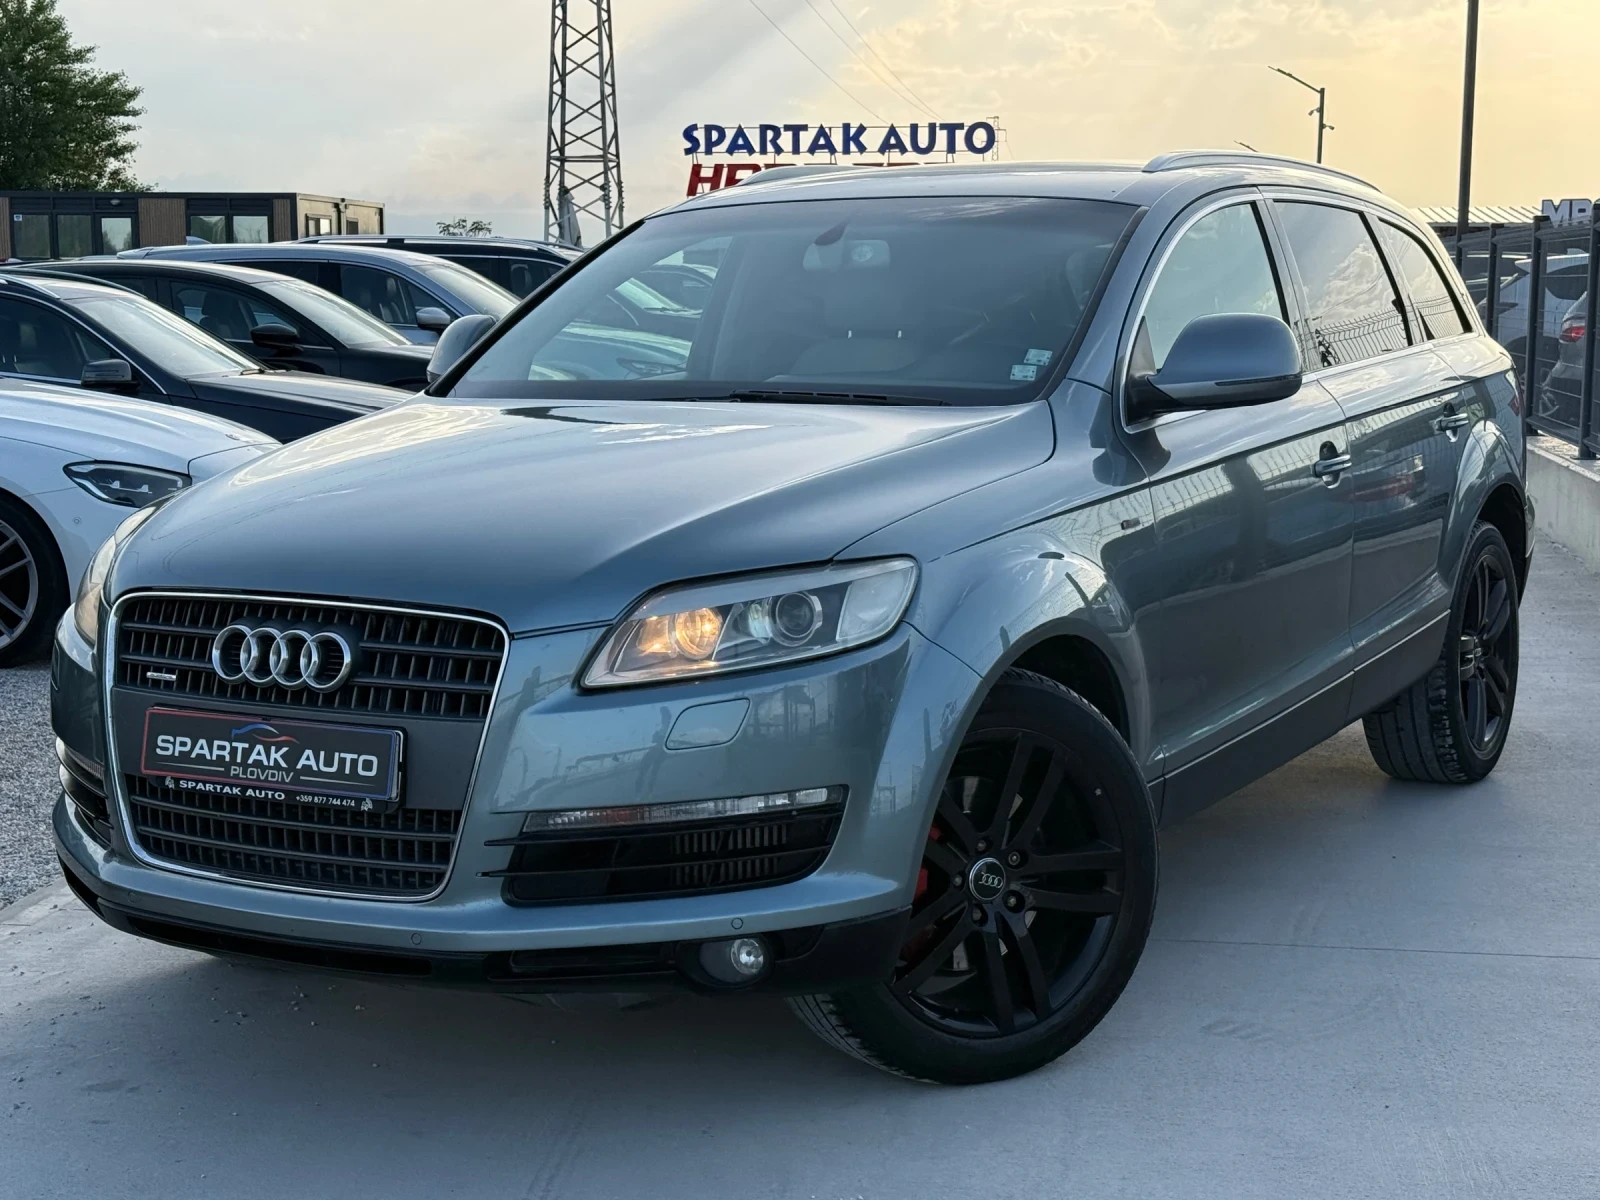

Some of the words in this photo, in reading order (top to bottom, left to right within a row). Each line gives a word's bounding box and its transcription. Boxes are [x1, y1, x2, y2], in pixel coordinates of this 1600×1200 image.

[683, 122, 867, 157] SPARTAK
[877, 121, 996, 157] AUTO
[155, 734, 290, 769] SPARTAK
[295, 748, 379, 777] AUTO
[229, 765, 295, 784] PLOVDIV
[179, 779, 242, 796] SPARTAK
[245, 788, 286, 801] AUTO
[295, 794, 313, 803] +359
[313, 796, 327, 804] 877
[327, 797, 341, 806] 744
[341, 799, 356, 807] 474
